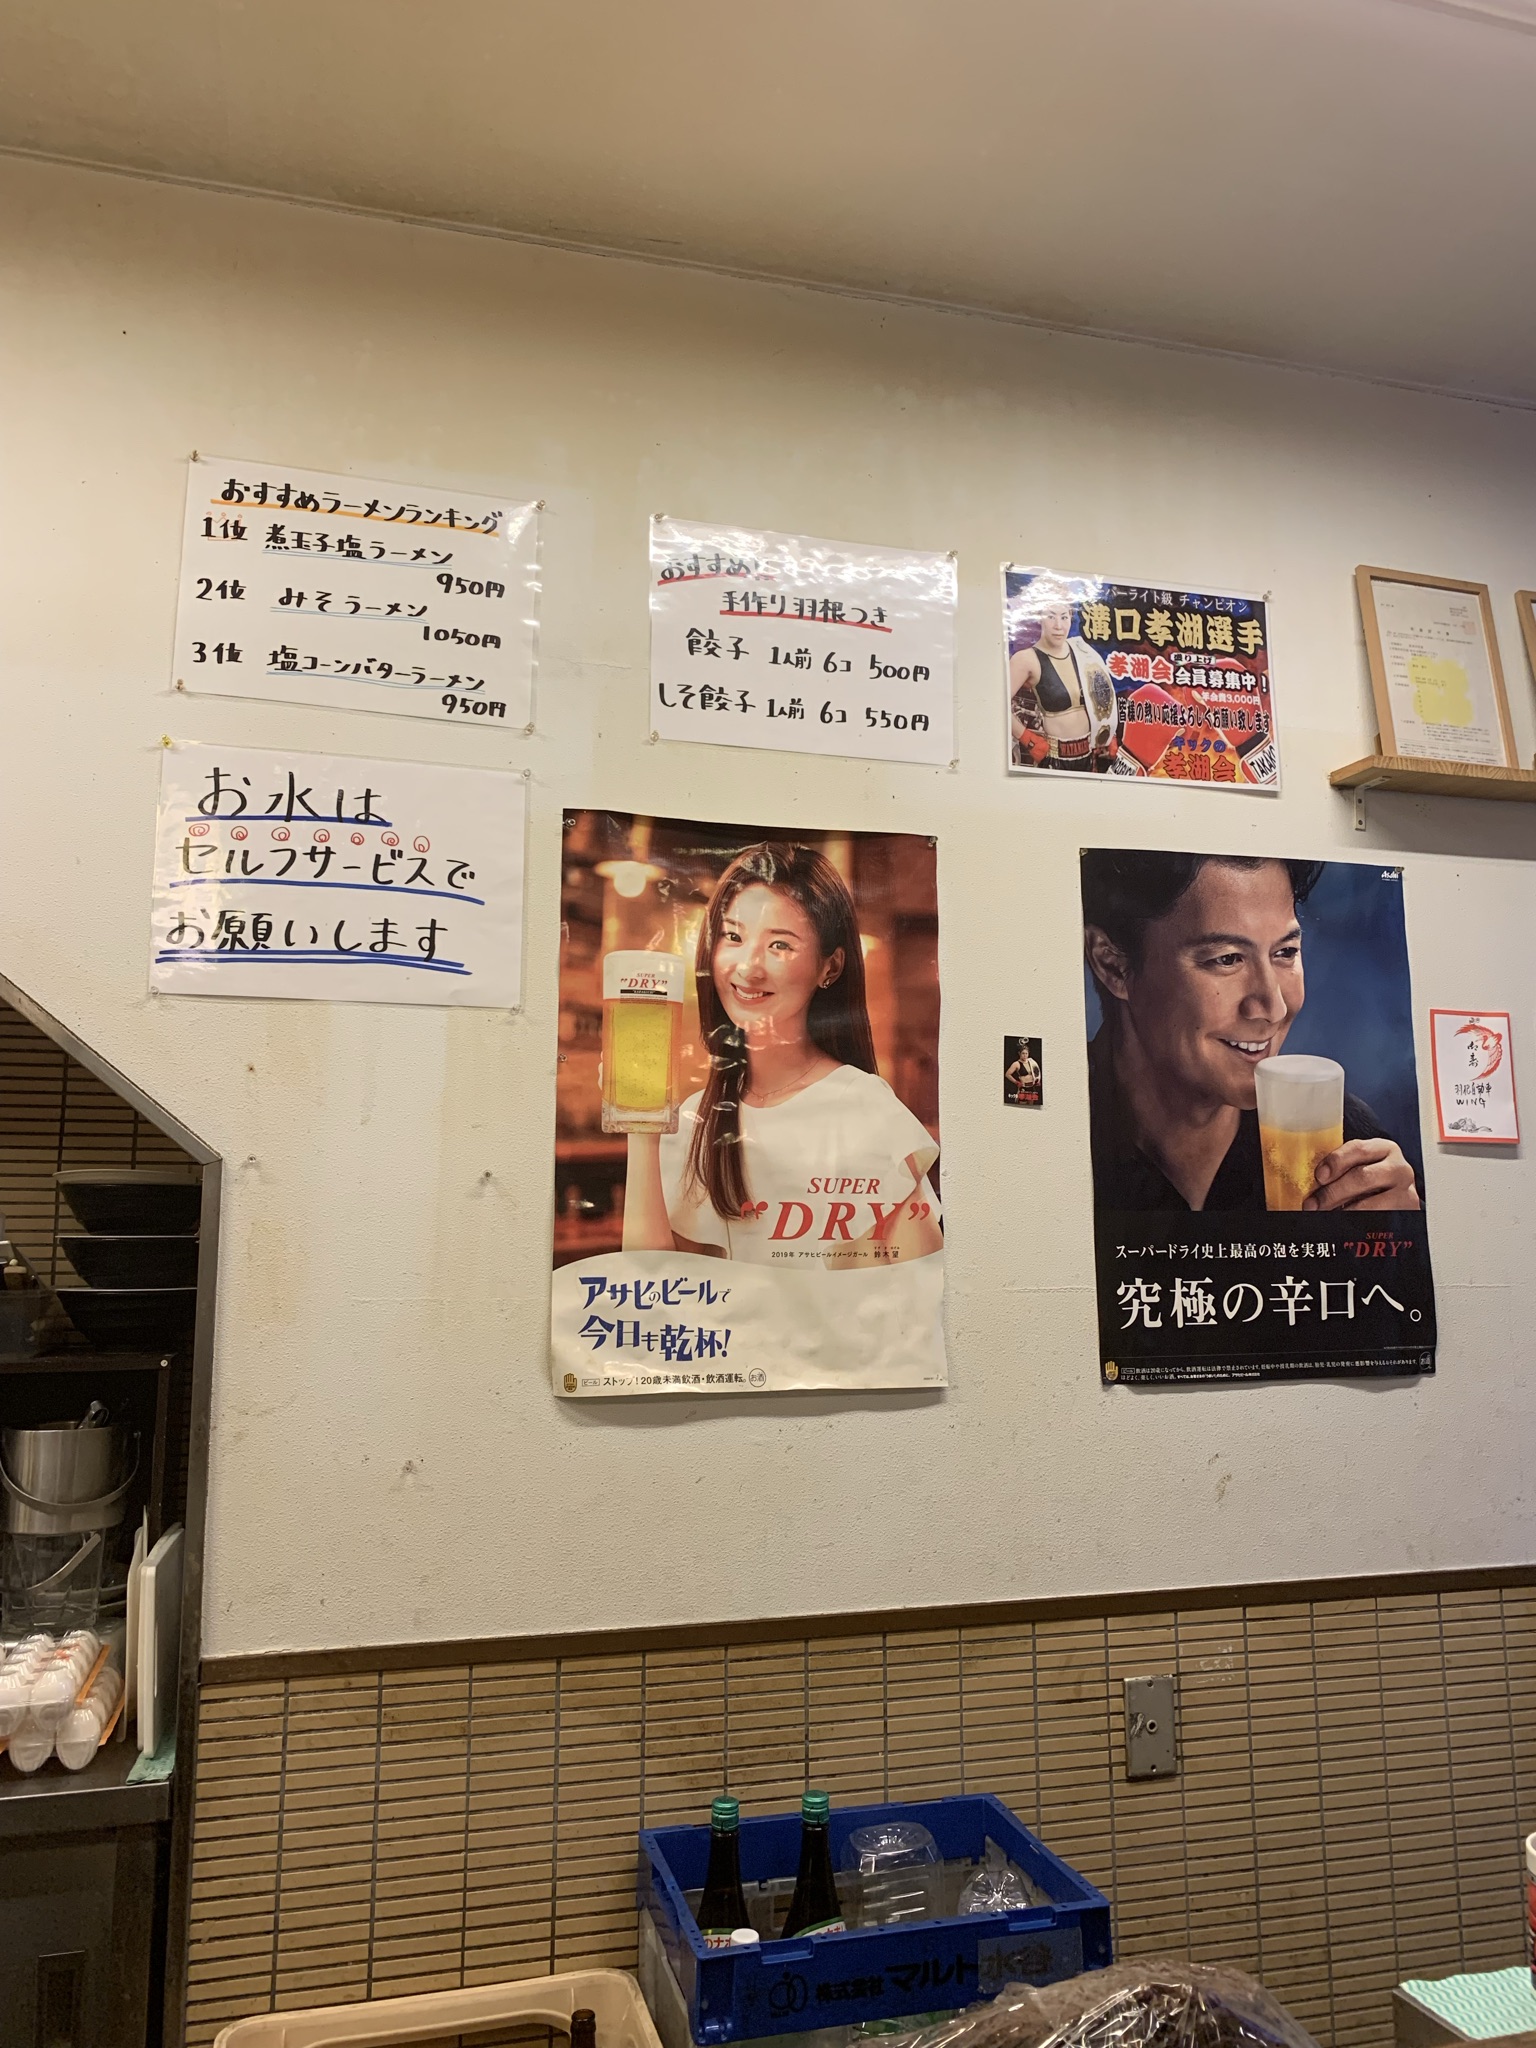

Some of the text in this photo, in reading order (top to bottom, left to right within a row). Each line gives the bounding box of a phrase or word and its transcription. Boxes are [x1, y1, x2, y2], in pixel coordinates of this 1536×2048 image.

[220, 478, 503, 534] おすすめラーメンランキング
[200, 517, 453, 565] 1位 煮玉子塩ラーメン
[196, 578, 428, 618] 2位 みそラーメン
[436, 573, 505, 598] 950円
[1091, 585, 1249, 613] ーパーライト級 チャンピオン
[722, 591, 888, 628] 手作り羽根つき
[422, 625, 502, 649] 1050円
[1081, 603, 1264, 655] 溝口孝湖選手
[192, 642, 486, 691] 3位 塩コーンバターラーメン
[686, 627, 930, 682] 餃子 1人前 6コ 500円
[1106, 651, 1268, 693] 孝湖会 会員募集中!
[441, 693, 506, 718] 950円
[658, 683, 929, 732] しそ餃子 1人前 6コ 550円
[1118, 697, 1271, 734] 皆様の熱い応援よろしくお願い致します
[1202, 692, 1261, 706] 年会費3,000円
[1172, 735, 1226, 753] キックの
[1163, 751, 1237, 783] 孝湖会
[197, 767, 387, 823] お水は
[175, 837, 476, 890] セルフサービスで
[166, 908, 449, 963] お願いします
[1456, 1098, 1486, 1109] WING
[807, 1177, 881, 1195] SUPER
[1115, 1242, 1337, 1260] スーパードライ史上最高の泡を実現!
[1365, 1231, 1395, 1240] SUPER
[771, 1250, 795, 1258] 2019年
[798, 1250, 869, 1259] アサヒビールイメージガール
[578, 1276, 732, 1310] アサヒのビールで
[1116, 1276, 1422, 1330] 究極の辛口へ。
[578, 1314, 732, 1362] 今日も乾杯!
